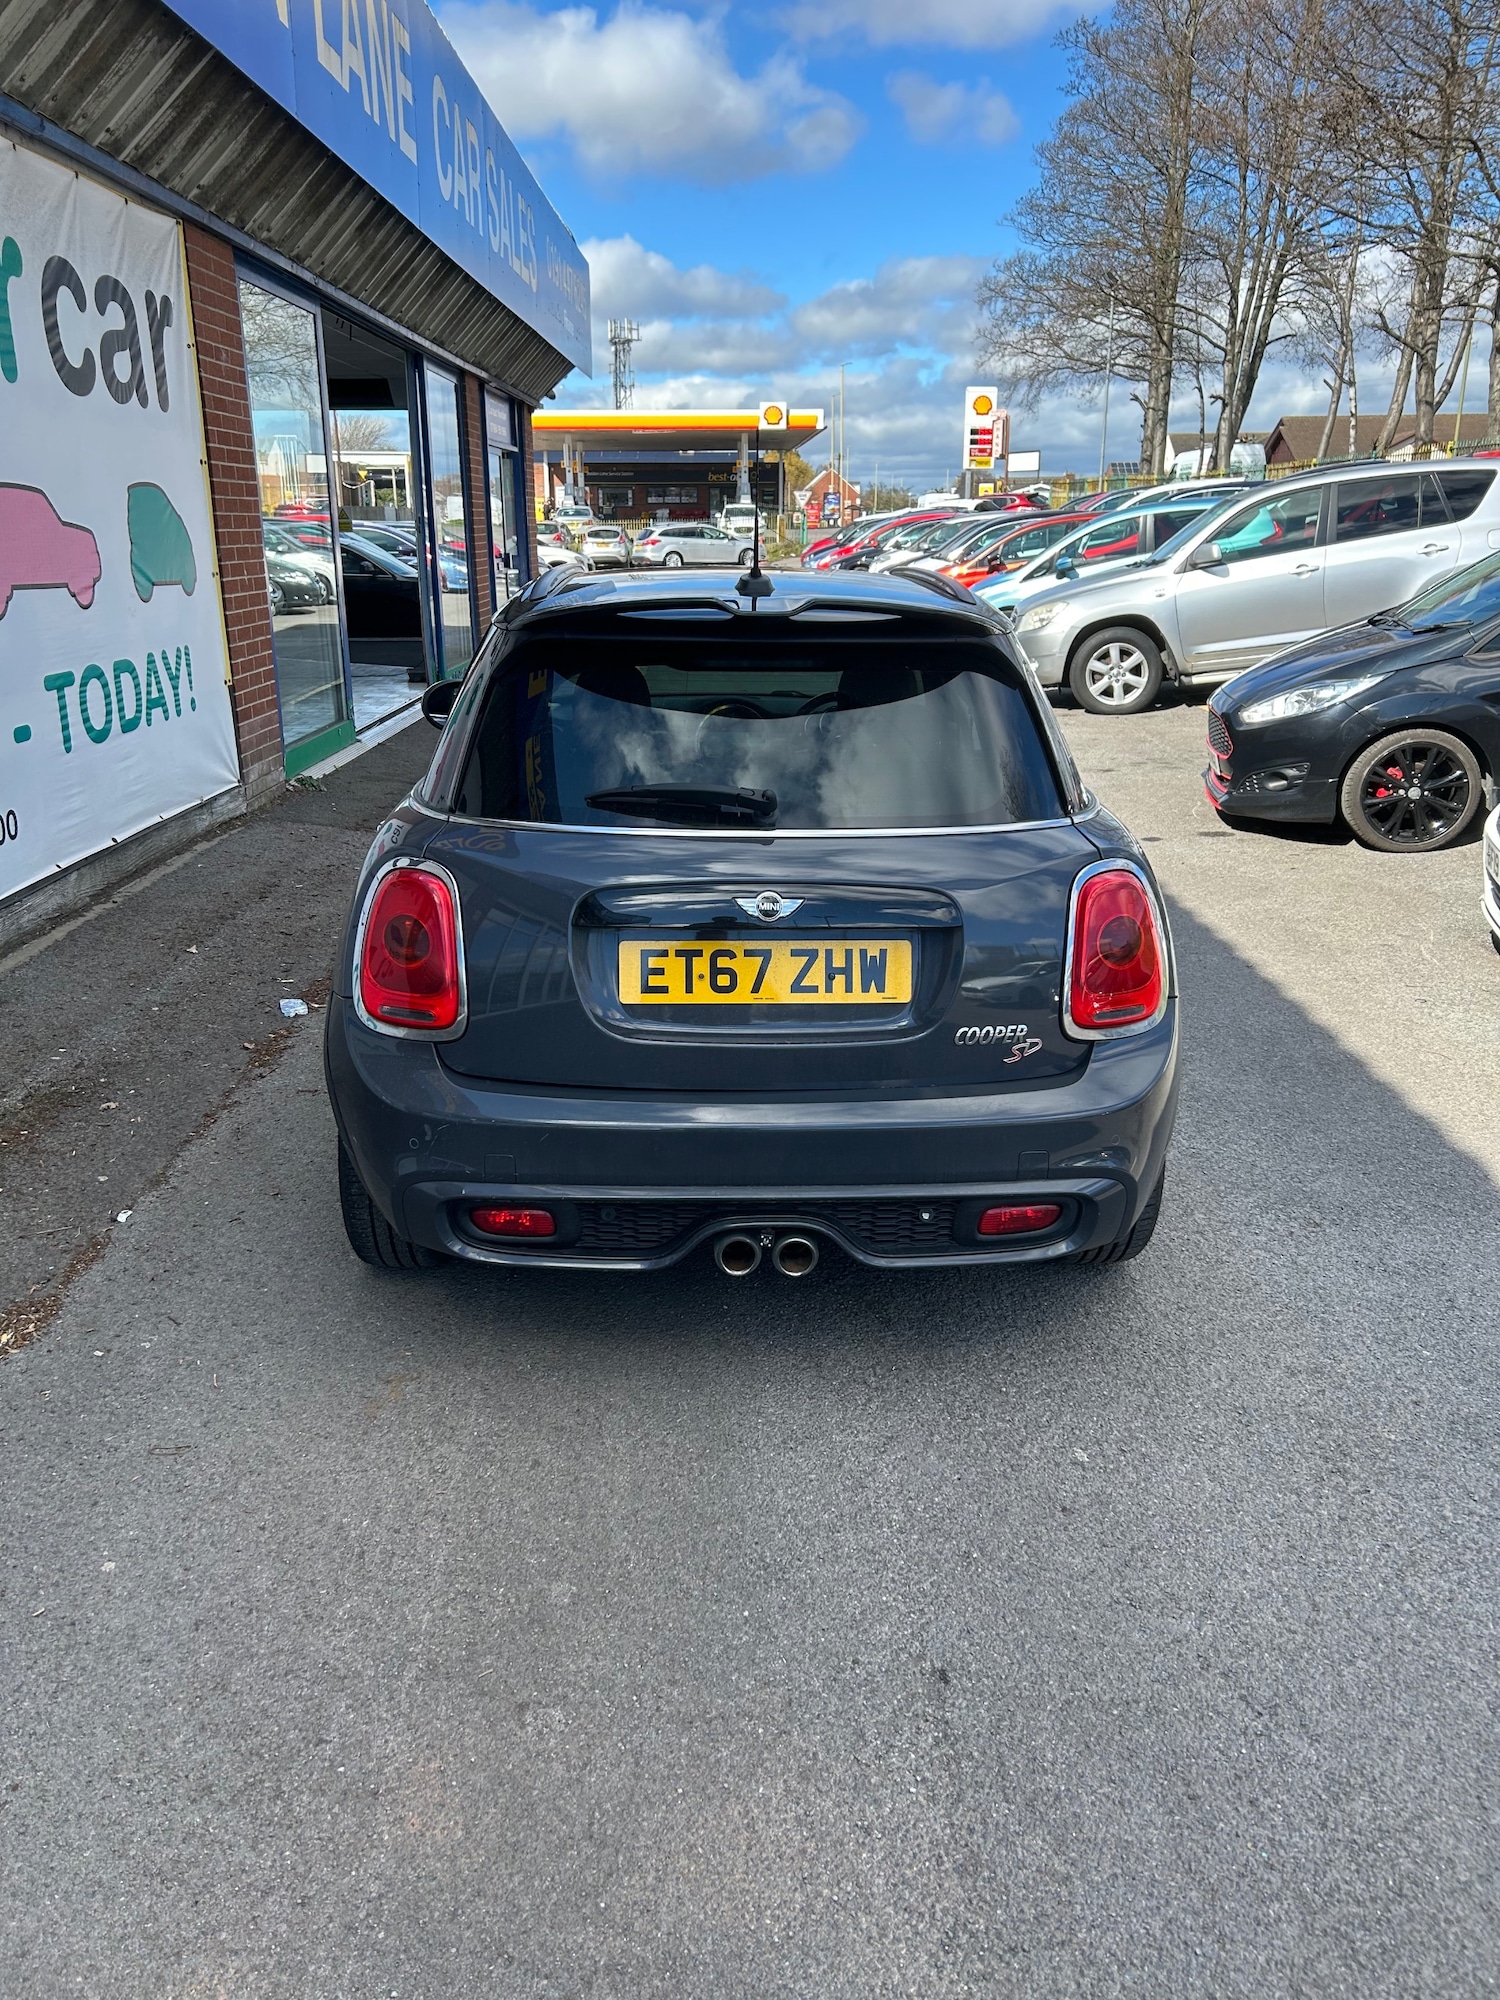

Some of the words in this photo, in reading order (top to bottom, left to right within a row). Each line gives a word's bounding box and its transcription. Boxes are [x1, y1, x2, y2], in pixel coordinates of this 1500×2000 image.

[313, 0, 418, 167] LANE
[432, 74, 484, 237] CAR
[485, 146, 538, 293] SALES
[42, 254, 174, 413] car
[43, 644, 197, 754] TODAY!
[759, 902, 780, 911] MINI
[640, 948, 773, 994] ET67
[790, 948, 888, 994] ZHW
[954, 1024, 1029, 1046] COOPER
[1003, 1038, 1043, 1064] SD
